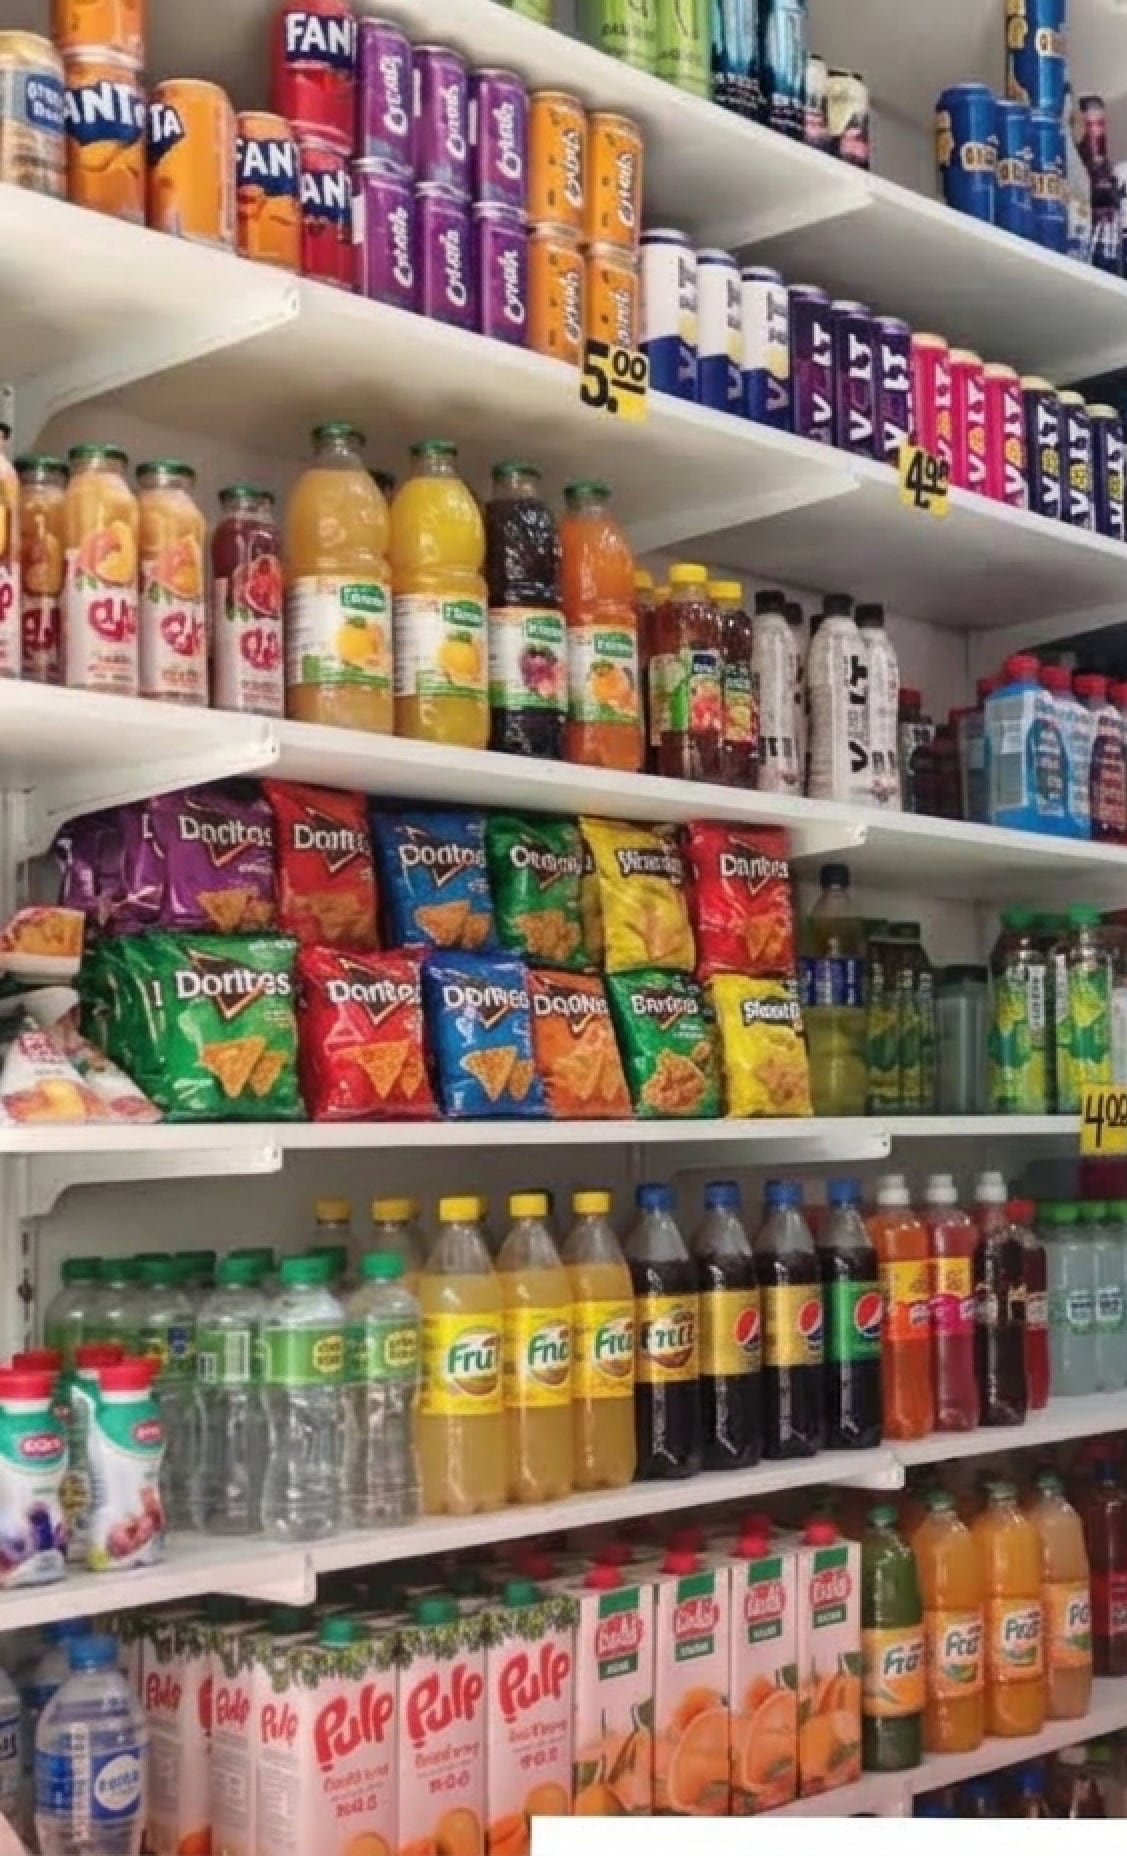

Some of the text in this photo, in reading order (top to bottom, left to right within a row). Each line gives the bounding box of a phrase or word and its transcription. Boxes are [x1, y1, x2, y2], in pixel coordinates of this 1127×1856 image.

[406, 1663, 484, 1749] Pulp
[497, 1642, 571, 1723] Pulp
[313, 1683, 394, 1773] Pulp
